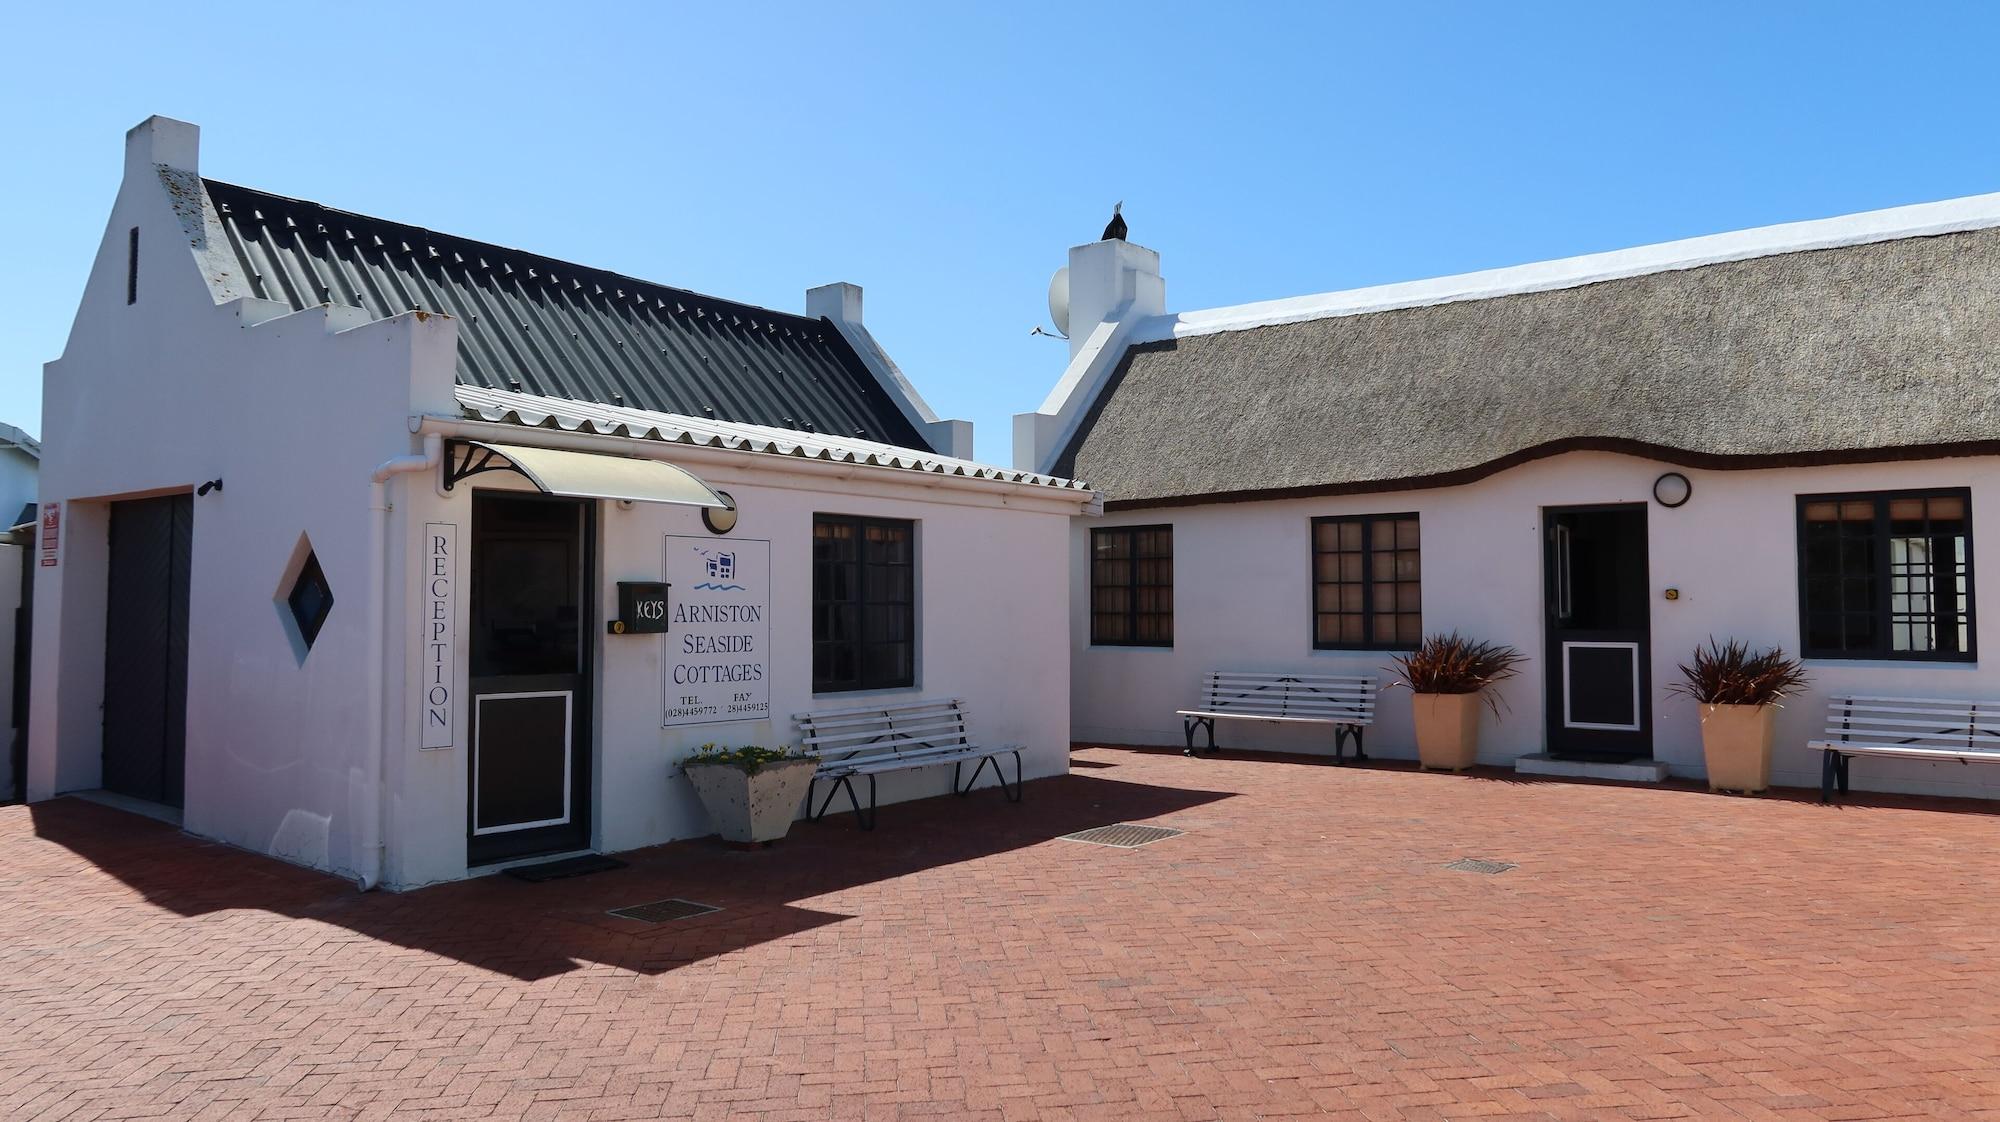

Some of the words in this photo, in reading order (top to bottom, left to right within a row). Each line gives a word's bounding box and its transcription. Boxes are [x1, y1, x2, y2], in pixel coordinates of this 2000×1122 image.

[636, 600, 664, 620] KEYS
[673, 602, 762, 623] ARNISTON
[429, 535, 448, 727] RECEPTION
[683, 633, 753, 654] SEASIDE
[673, 663, 762, 685] COTTAGES
[680, 695, 703, 706] TEL.
[720, 702, 768, 714] 28)4459125
